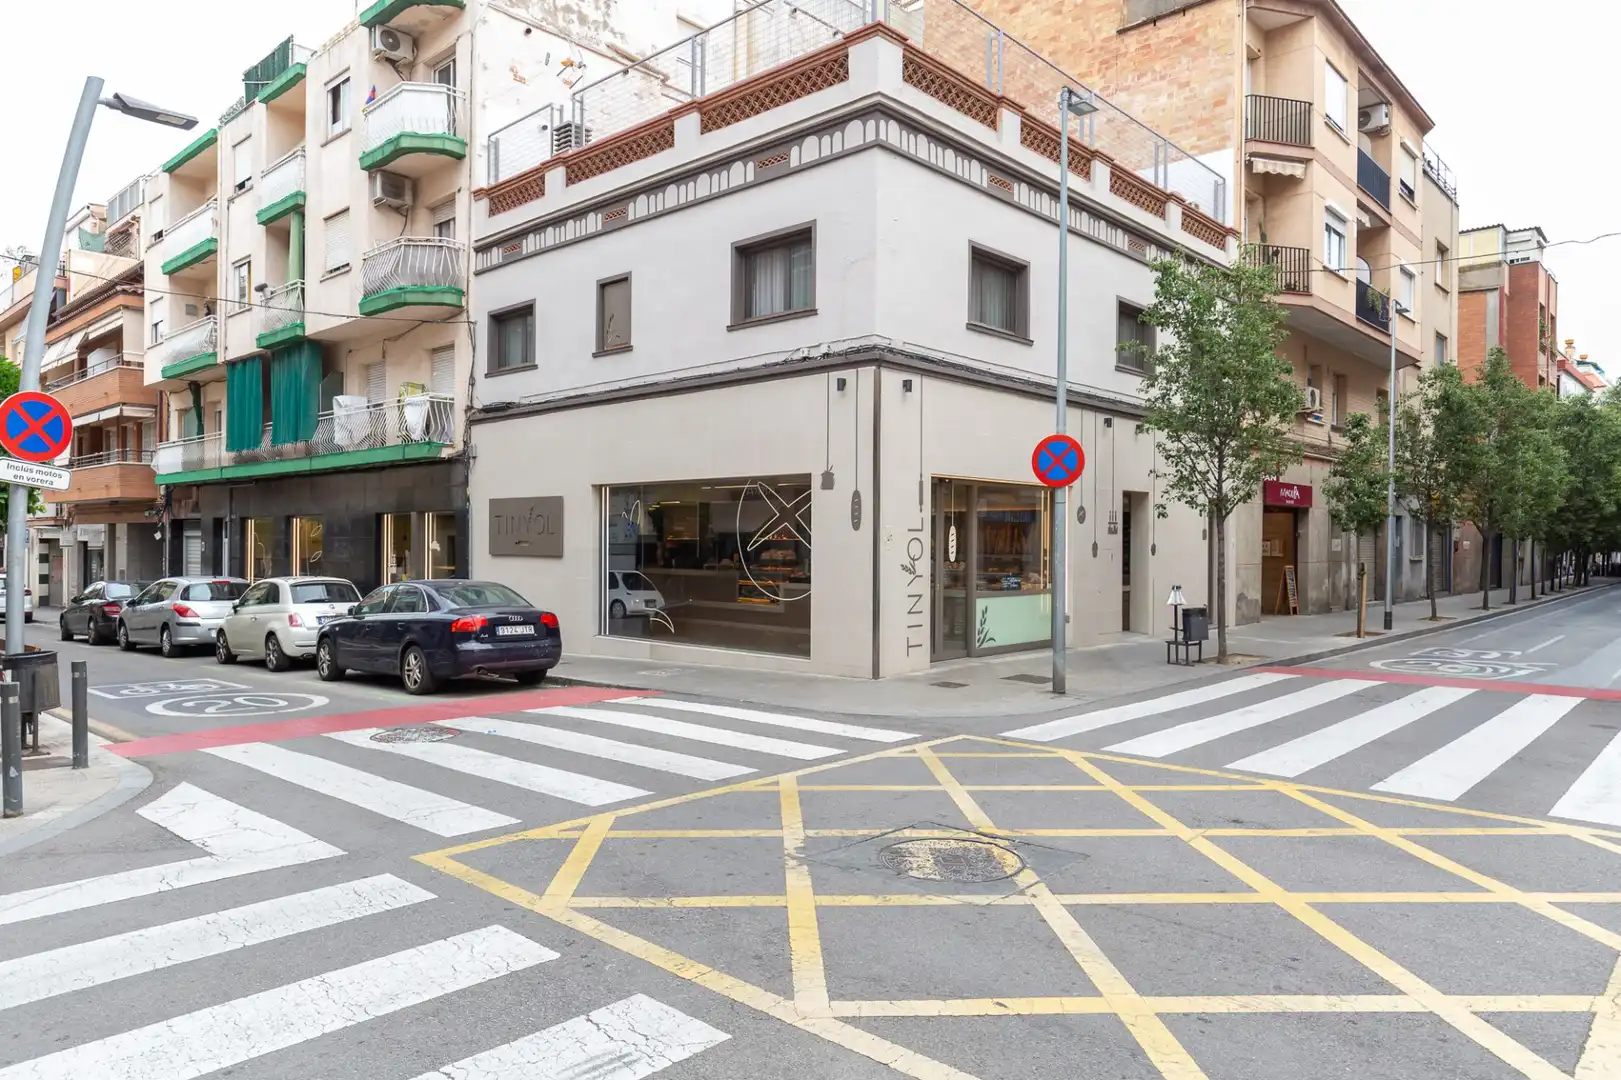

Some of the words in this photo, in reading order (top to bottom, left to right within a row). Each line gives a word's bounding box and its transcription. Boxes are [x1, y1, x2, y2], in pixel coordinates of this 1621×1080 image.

[6, 462, 34, 474] Inclús
[35, 469, 63, 479] motos
[26, 475, 54, 486] vorera
[494, 510, 556, 535] TINYOL
[905, 517, 923, 657] TINYOL
[182, 696, 288, 713] 20
